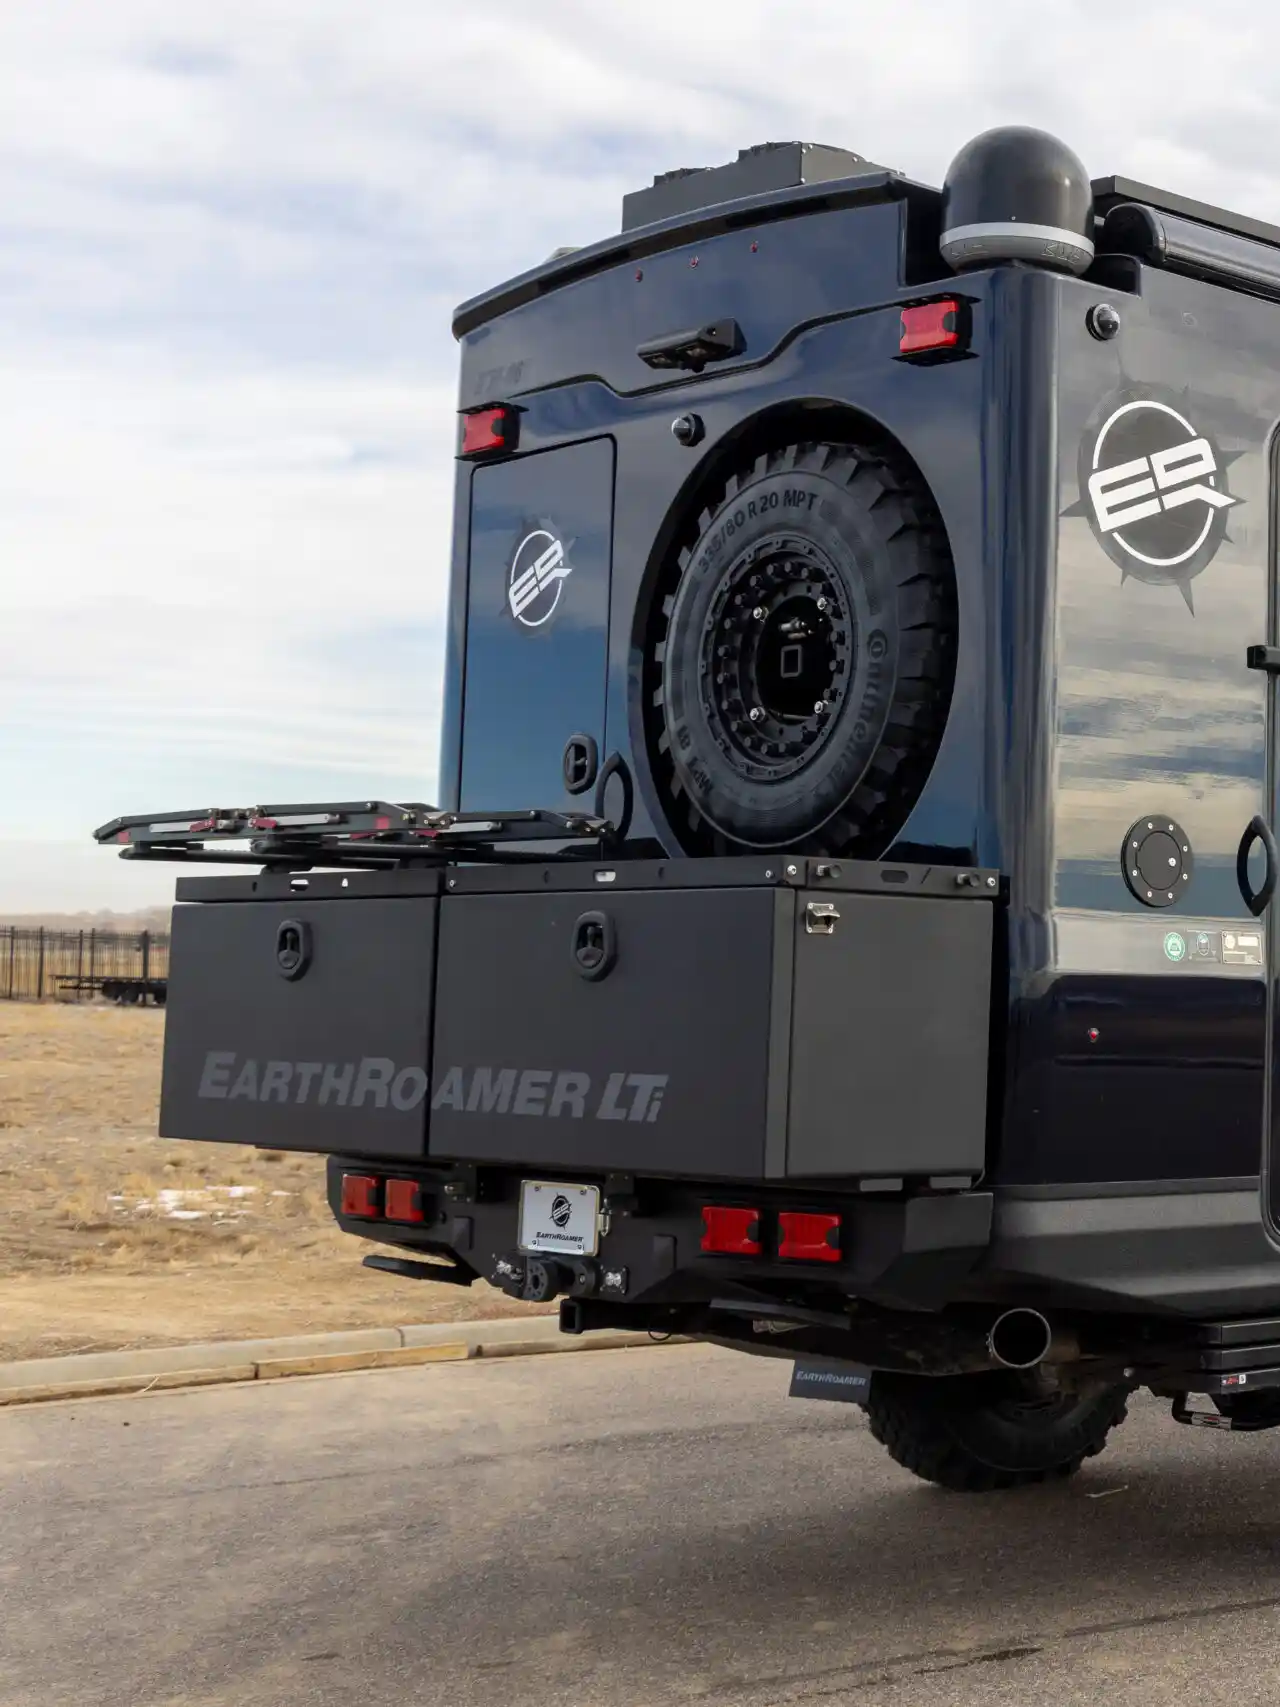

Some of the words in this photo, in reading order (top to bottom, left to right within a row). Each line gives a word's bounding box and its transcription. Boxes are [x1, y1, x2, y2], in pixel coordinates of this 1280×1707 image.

[747, 501, 758, 520] R
[759, 491, 779, 514] 20
[782, 488, 820, 511] MPT
